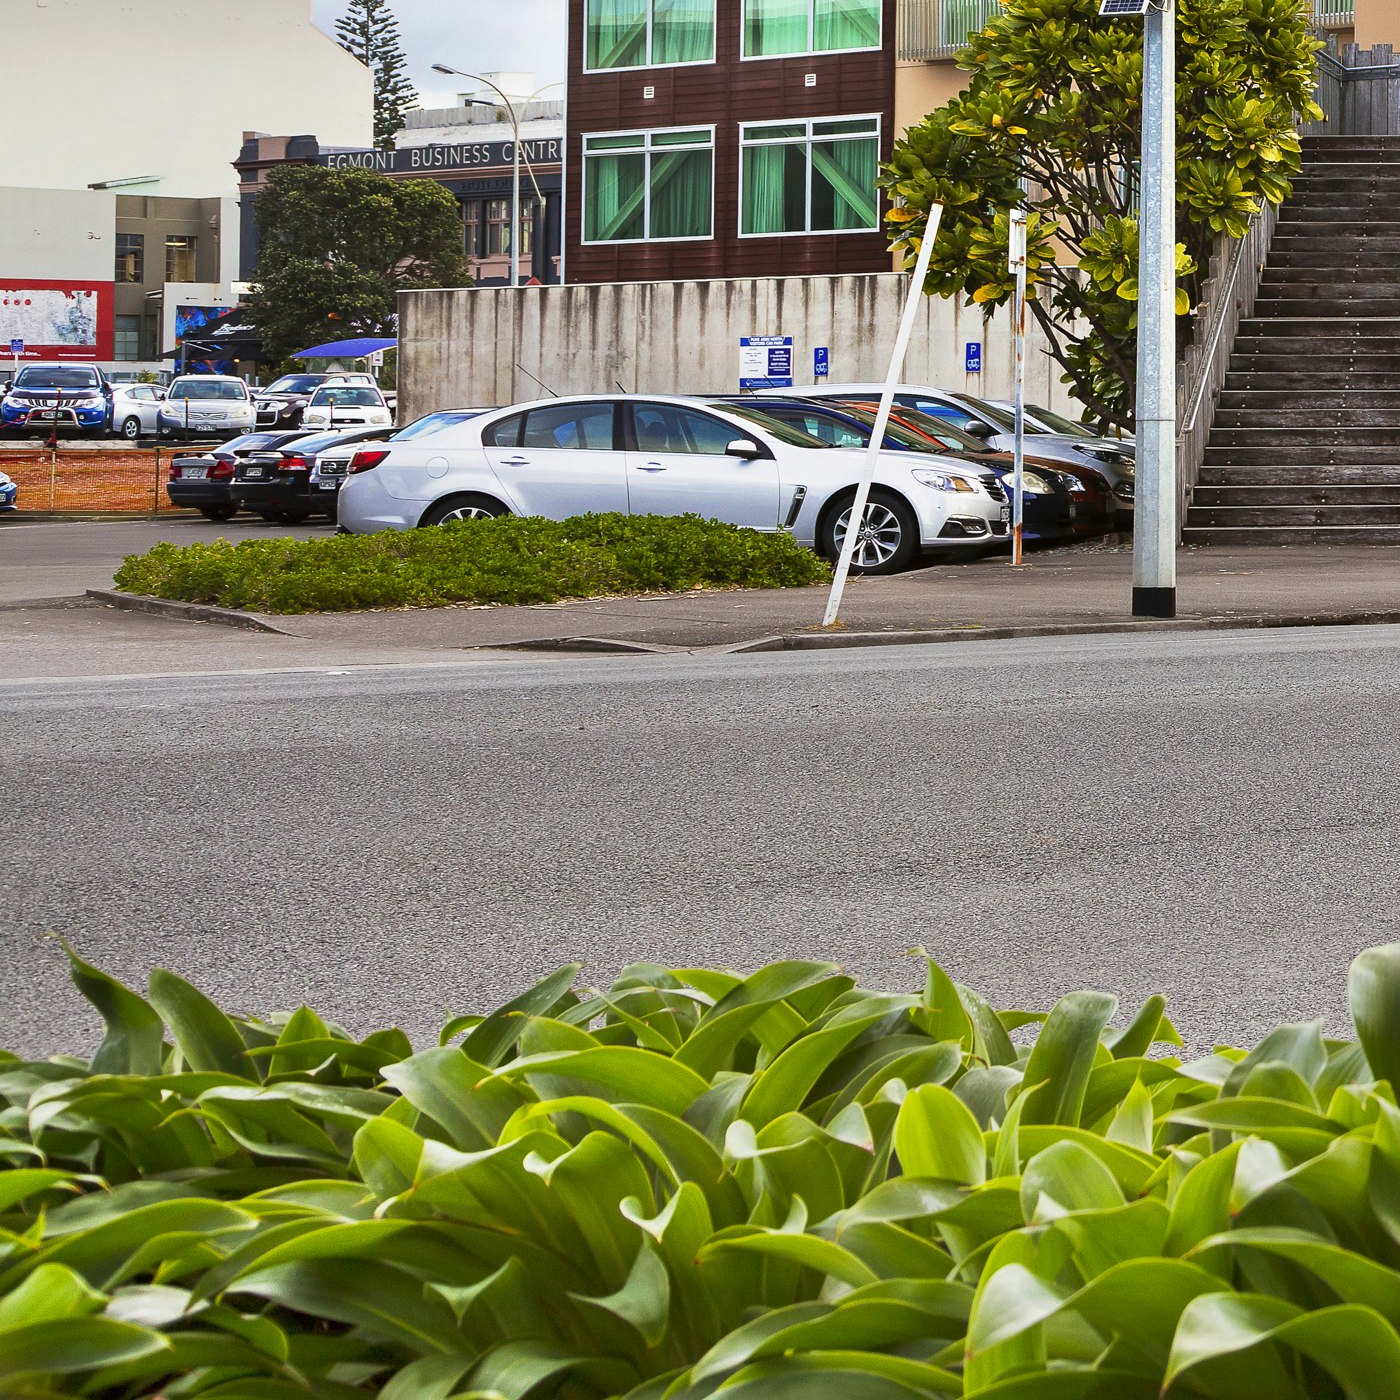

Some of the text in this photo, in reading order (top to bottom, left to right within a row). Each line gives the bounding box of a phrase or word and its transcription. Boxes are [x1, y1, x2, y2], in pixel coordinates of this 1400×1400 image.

[327, 140, 562, 170] EGMONT BUSINESS CENTR
[818, 349, 824, 360] P
[970, 344, 977, 355] P
